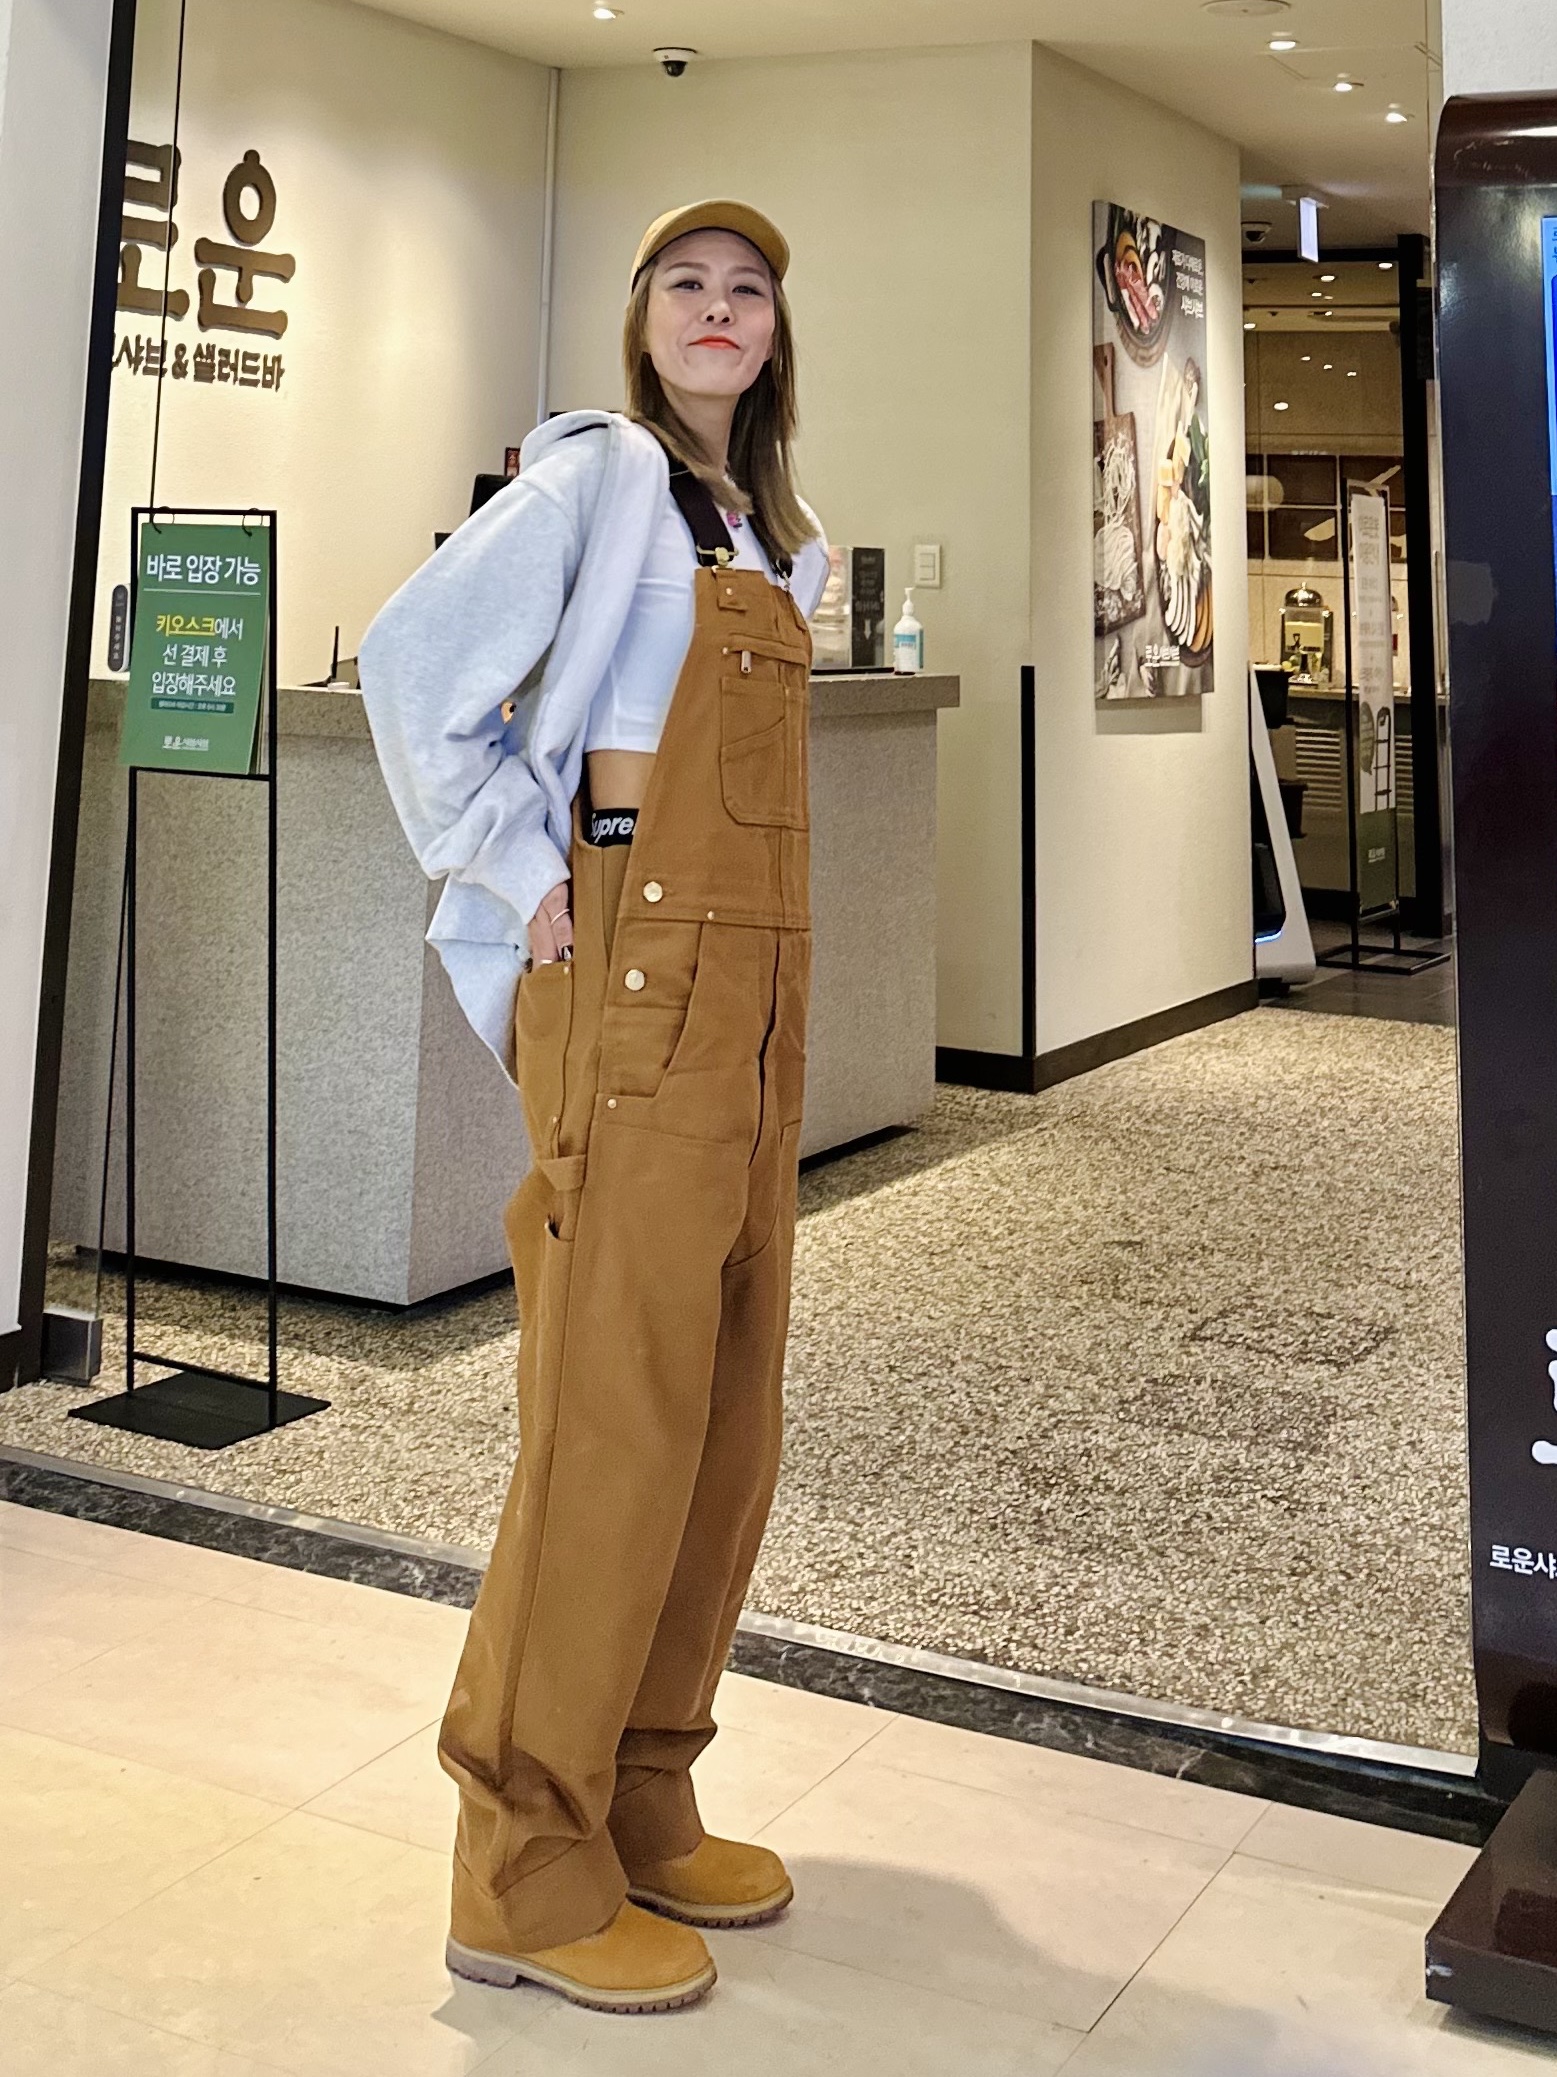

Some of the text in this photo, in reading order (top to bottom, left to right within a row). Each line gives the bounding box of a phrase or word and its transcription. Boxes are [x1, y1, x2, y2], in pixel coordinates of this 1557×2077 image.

[147, 554, 261, 586] 바로 입장 가능
[156, 614, 244, 641] 키오스크에서
[162, 643, 228, 669] 선 결제 후
[151, 671, 236, 697] 입장해주세요
[1490, 1544, 1557, 1580] 로운샤
